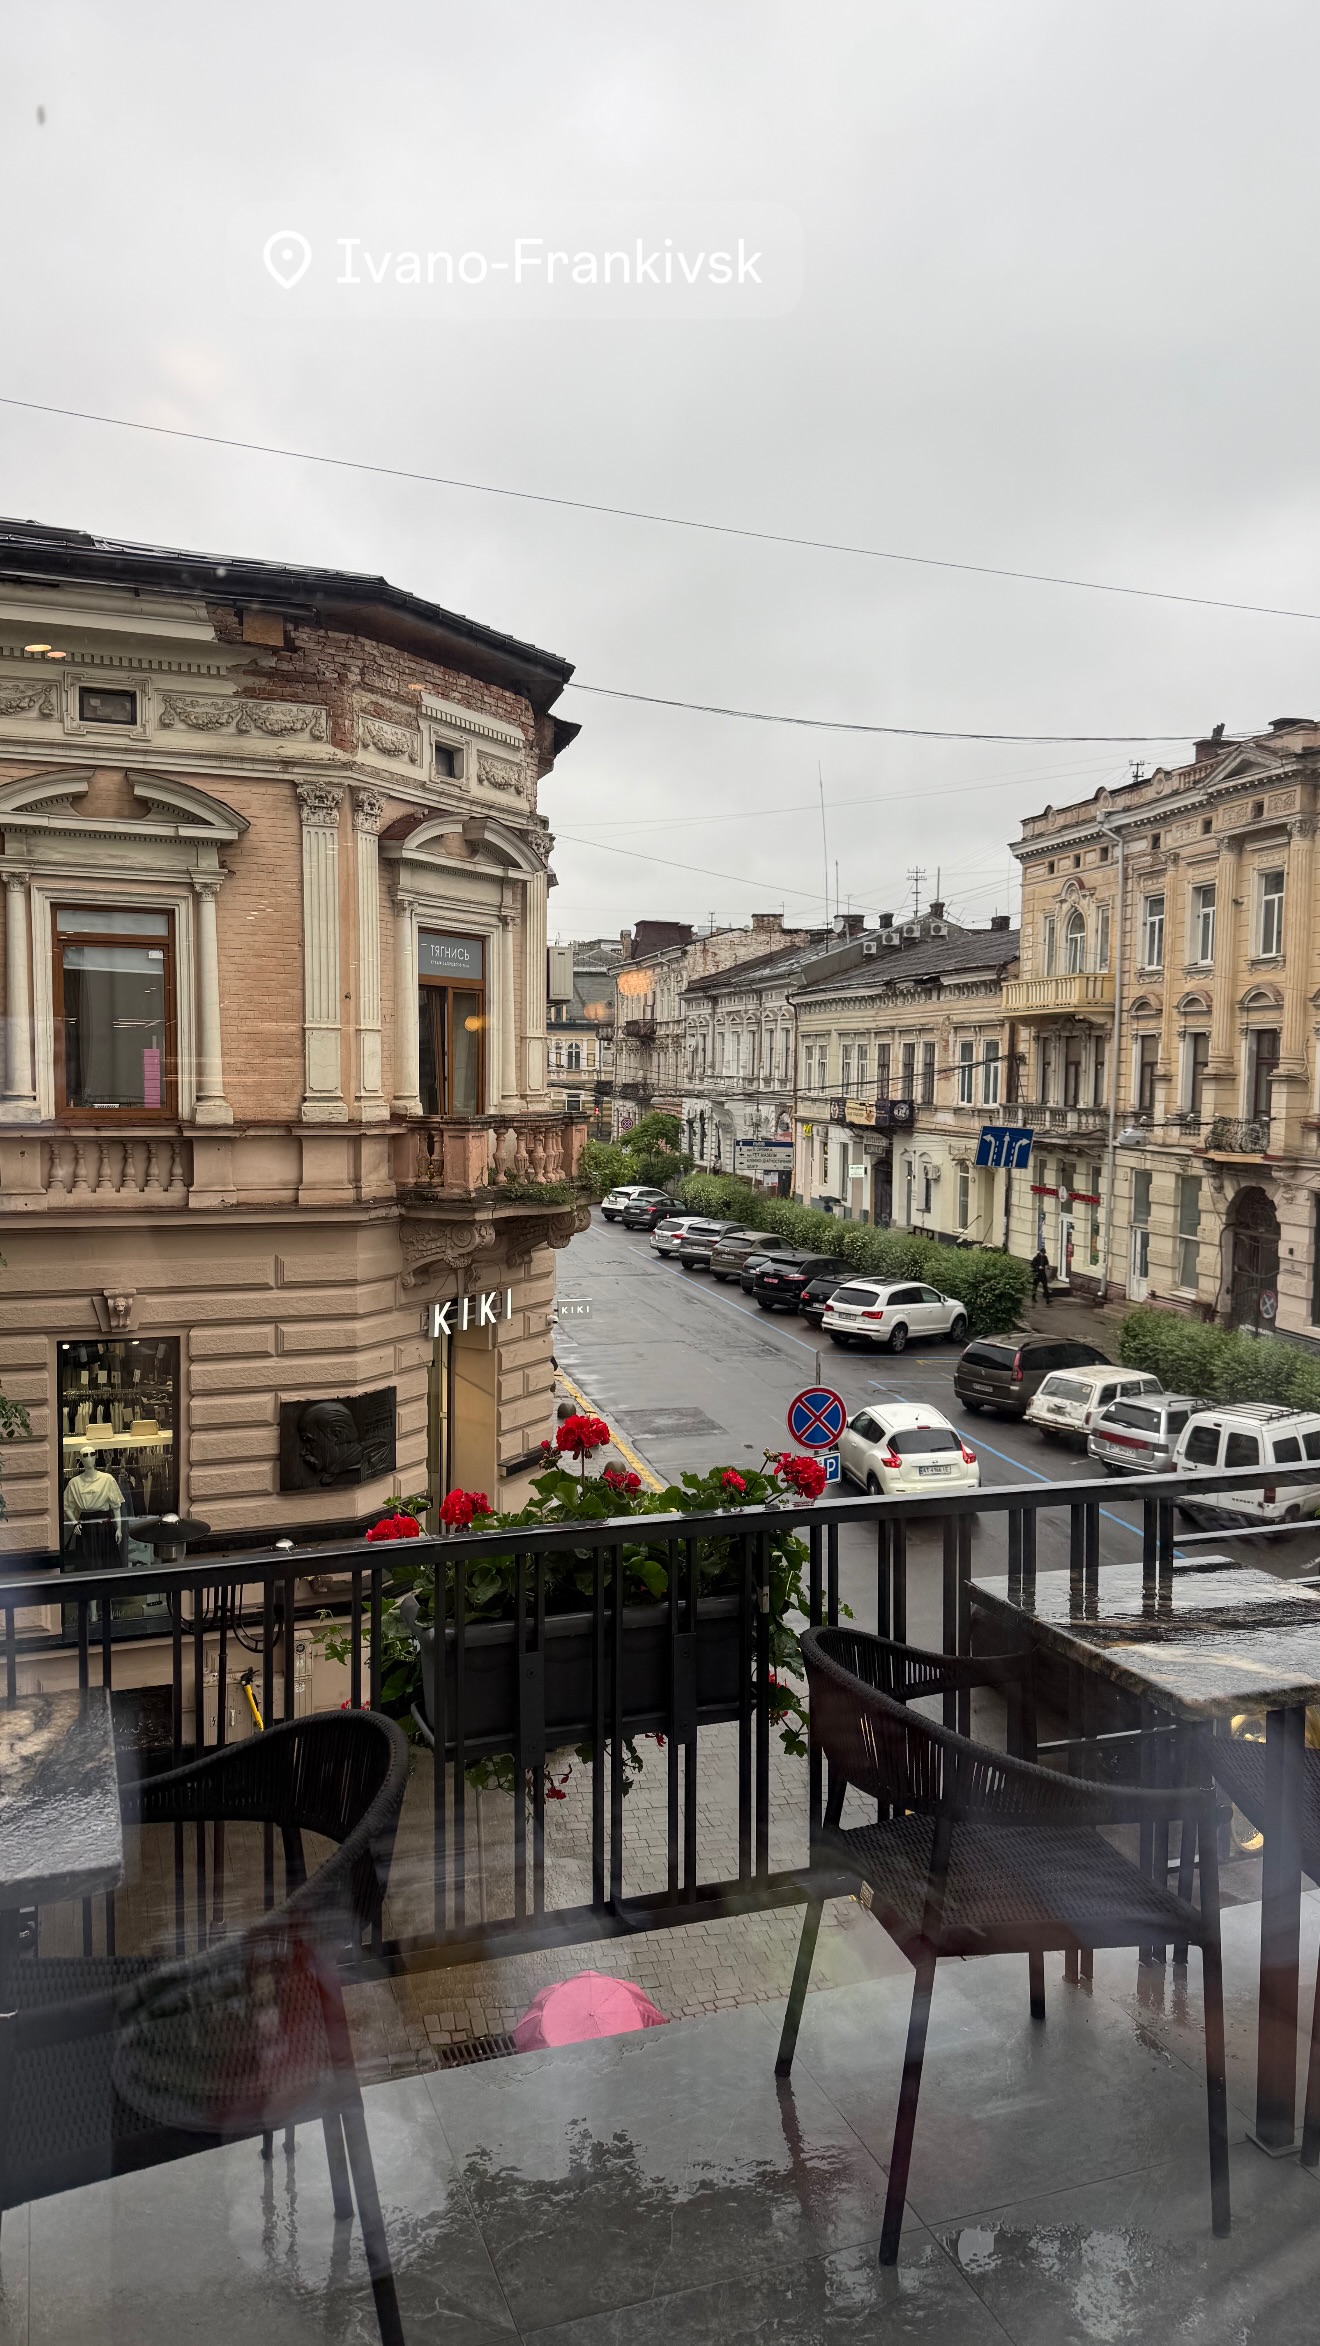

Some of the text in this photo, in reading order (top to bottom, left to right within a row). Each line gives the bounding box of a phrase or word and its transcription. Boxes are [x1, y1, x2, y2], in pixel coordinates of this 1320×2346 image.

[430, 944, 470, 961] ТЯГНИСЬ
[430, 1288, 512, 1337] KIKI
[561, 1304, 590, 1314] KIKI
[826, 1458, 836, 1479] P
